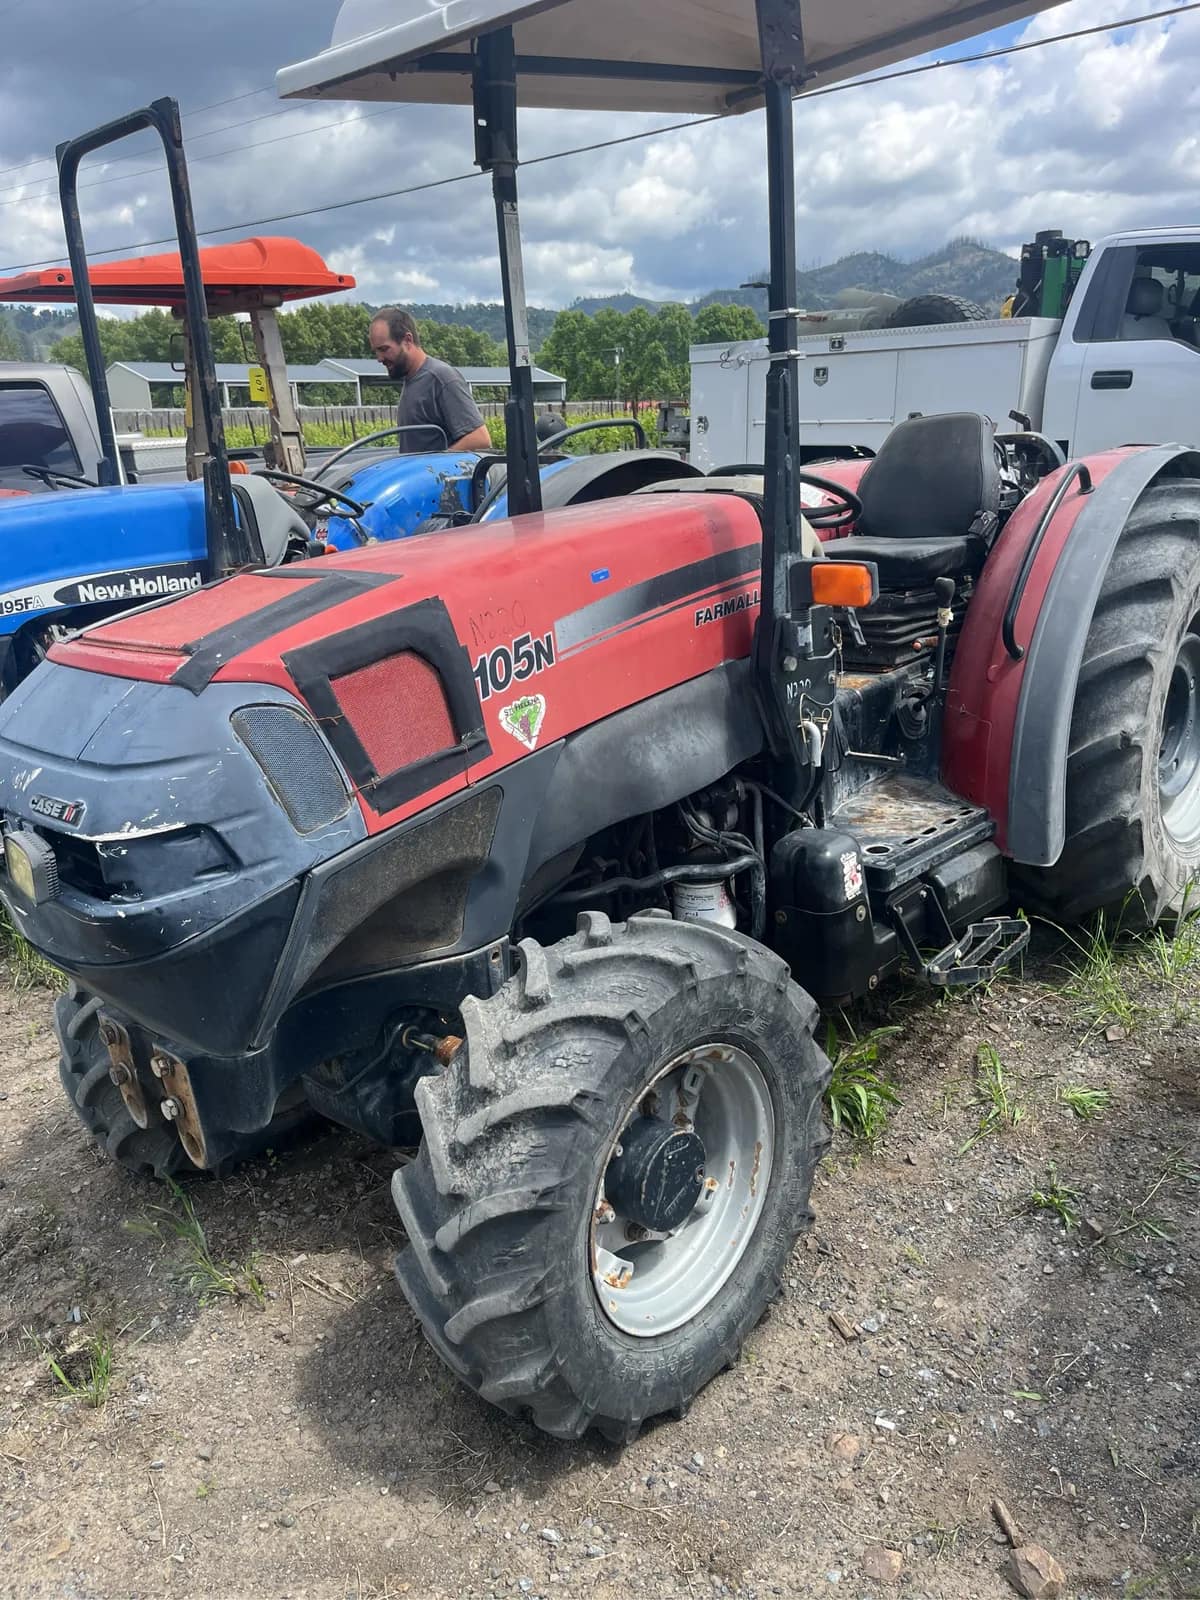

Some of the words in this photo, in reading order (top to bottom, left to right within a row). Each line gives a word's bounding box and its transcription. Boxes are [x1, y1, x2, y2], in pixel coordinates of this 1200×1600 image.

[78, 582, 124, 603] New
[129, 572, 202, 597] Holland
[695, 589, 760, 627] FARMALL
[473, 631, 555, 702] 105N
[29, 796, 63, 818] CASE
